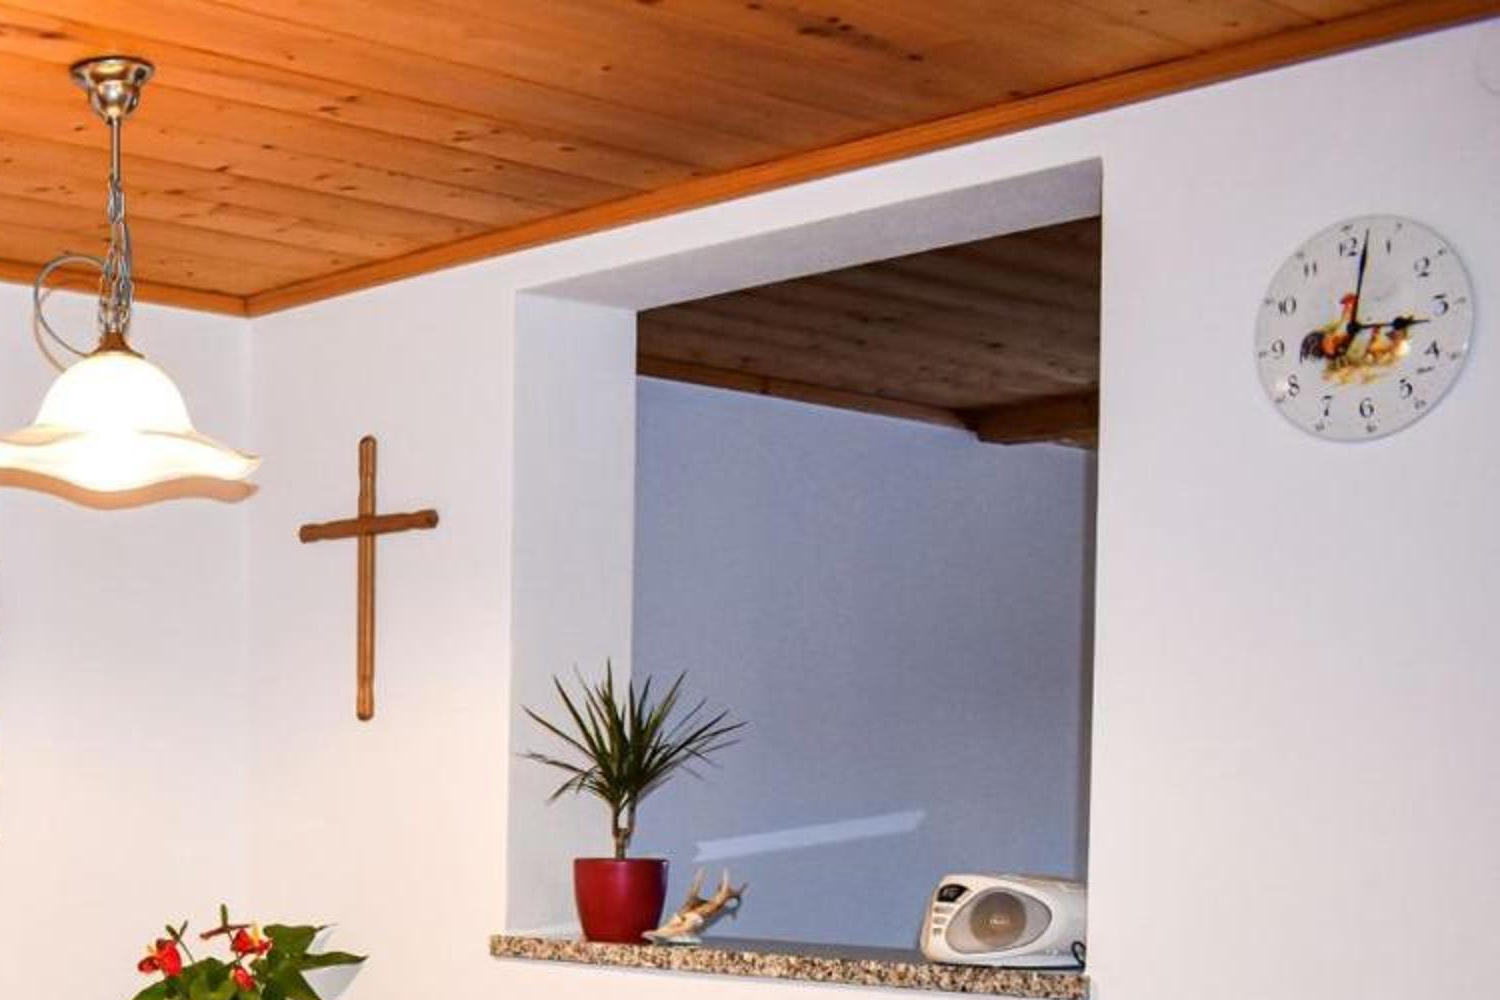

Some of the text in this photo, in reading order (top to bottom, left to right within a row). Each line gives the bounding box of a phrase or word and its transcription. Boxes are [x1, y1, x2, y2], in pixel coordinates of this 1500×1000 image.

[1338, 236, 1358, 257] 12
[1385, 239, 1392, 254] 1
[1303, 261, 1317, 277] 11
[1414, 256, 1431, 278] 2
[1277, 296, 1297, 316] 10
[1431, 293, 1450, 316] 3
[1271, 339, 1286, 360] 9
[1423, 340, 1441, 359] 4
[1286, 374, 1301, 398] 8
[1399, 378, 1414, 399] 5
[1321, 394, 1333, 418] 7
[1358, 397, 1375, 419] 6
